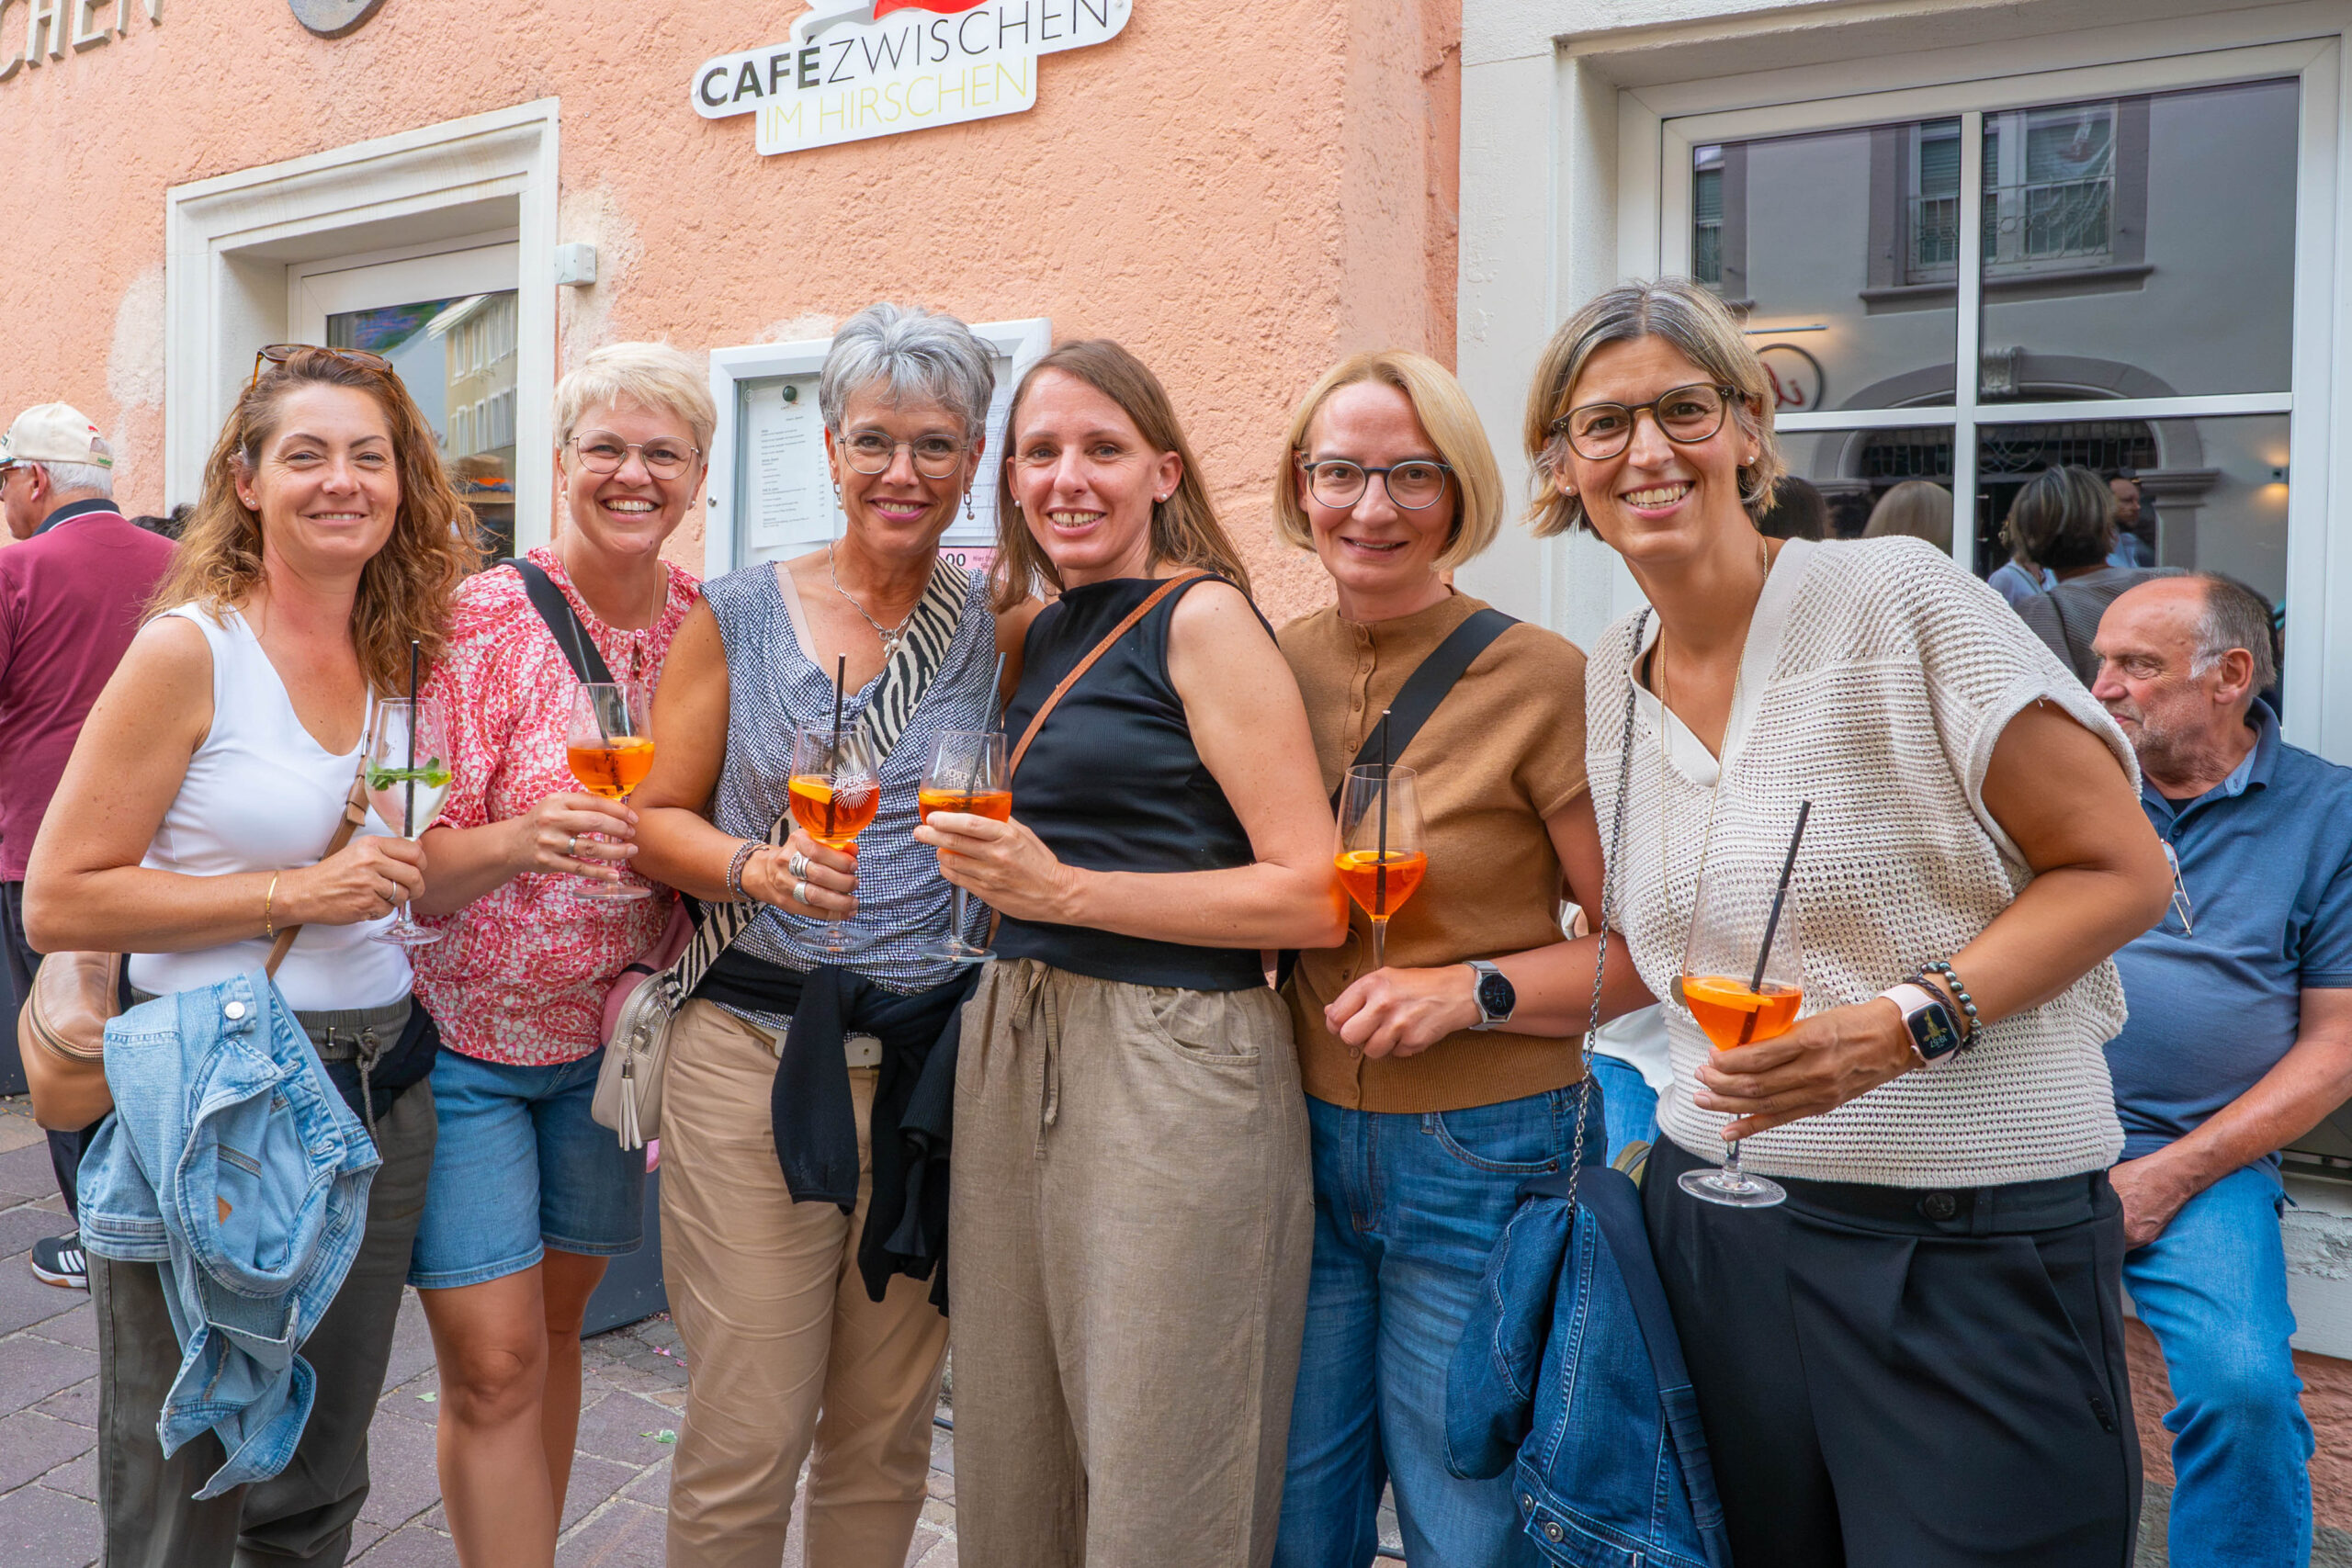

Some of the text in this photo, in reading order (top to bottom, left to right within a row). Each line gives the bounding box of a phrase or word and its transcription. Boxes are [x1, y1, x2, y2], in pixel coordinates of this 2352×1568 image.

[766, 57, 1027, 144] IM HIRSCHEN
[832, 772, 869, 791] APEROL
